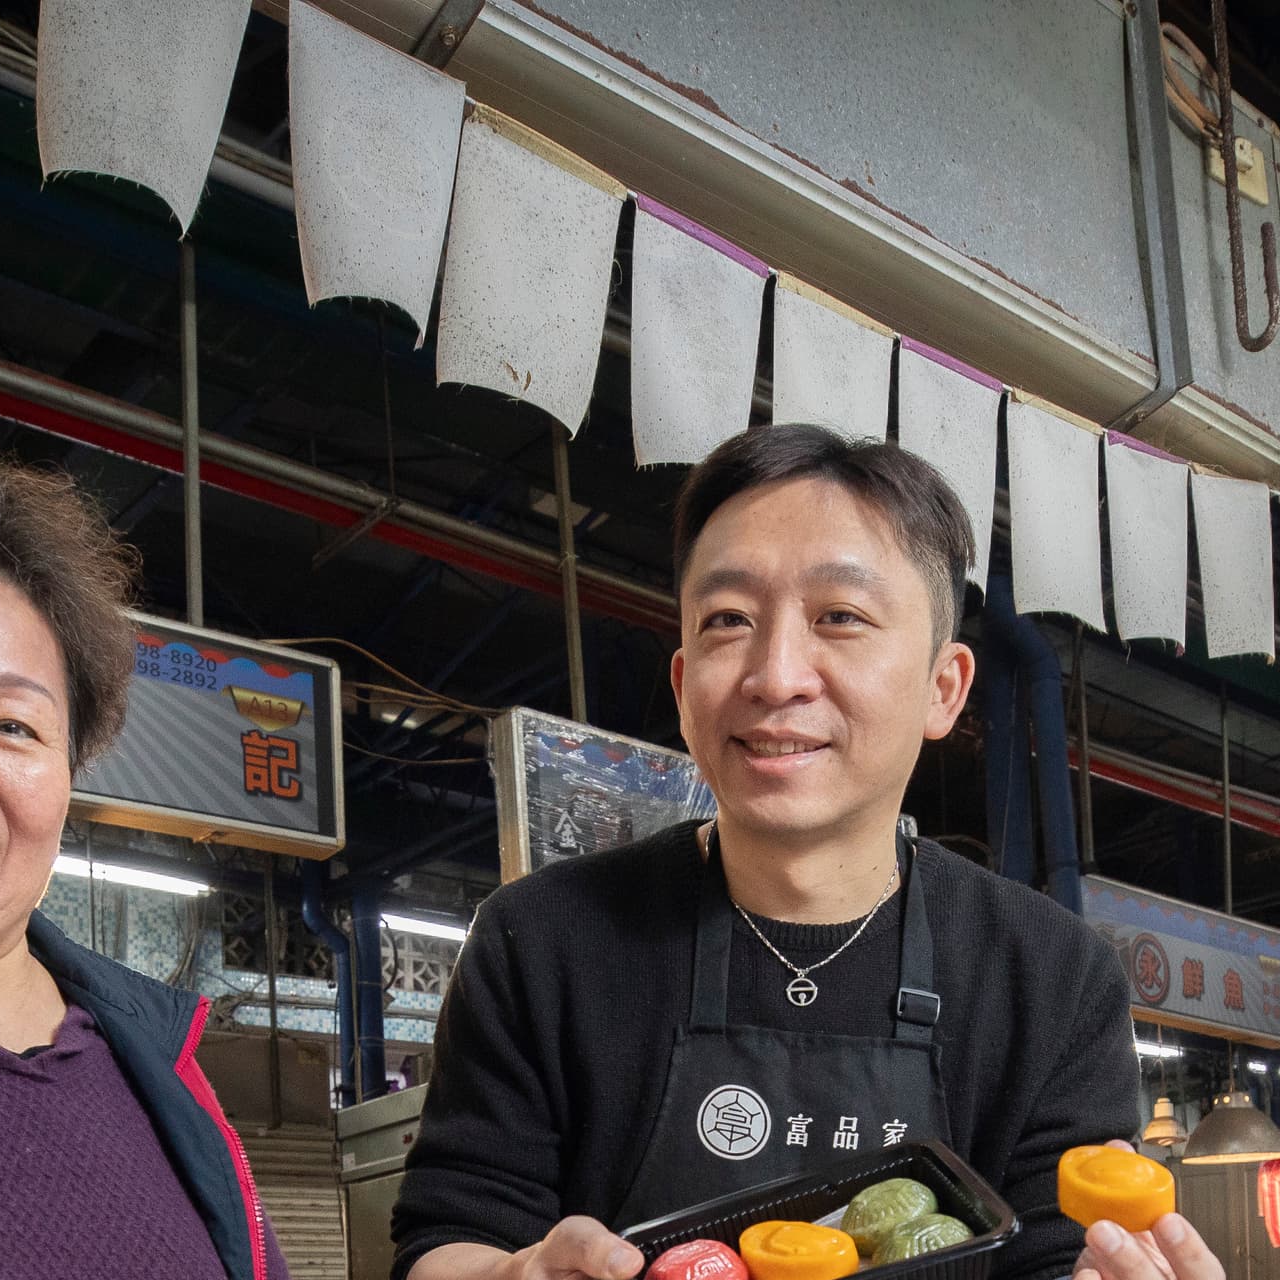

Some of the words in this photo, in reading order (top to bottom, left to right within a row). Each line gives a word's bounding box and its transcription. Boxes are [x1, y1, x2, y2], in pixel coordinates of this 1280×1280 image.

[249, 696, 289, 721] A13
[241, 731, 300, 799] 記
[786, 1113, 909, 1151] 富品家
